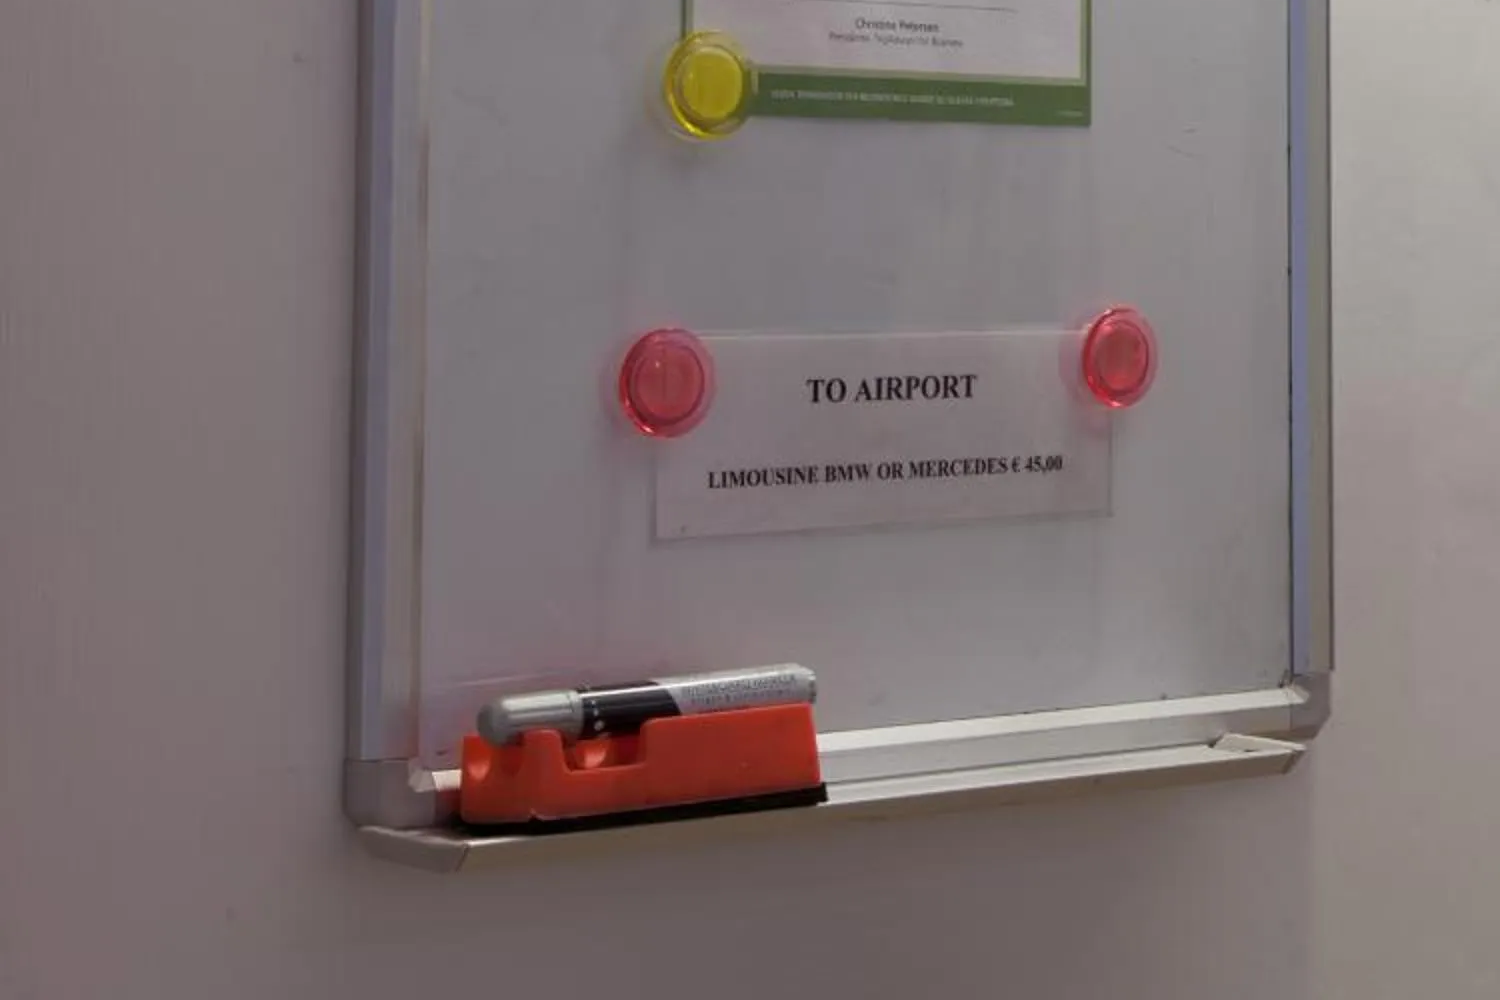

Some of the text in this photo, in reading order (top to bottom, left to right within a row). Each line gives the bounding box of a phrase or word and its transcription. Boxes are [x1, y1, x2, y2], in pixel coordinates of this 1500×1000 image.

[806, 374, 978, 404] TO AIRPORT
[707, 454, 1064, 489] LIMOUSINE BMW OR MERCEDES € 45,00
